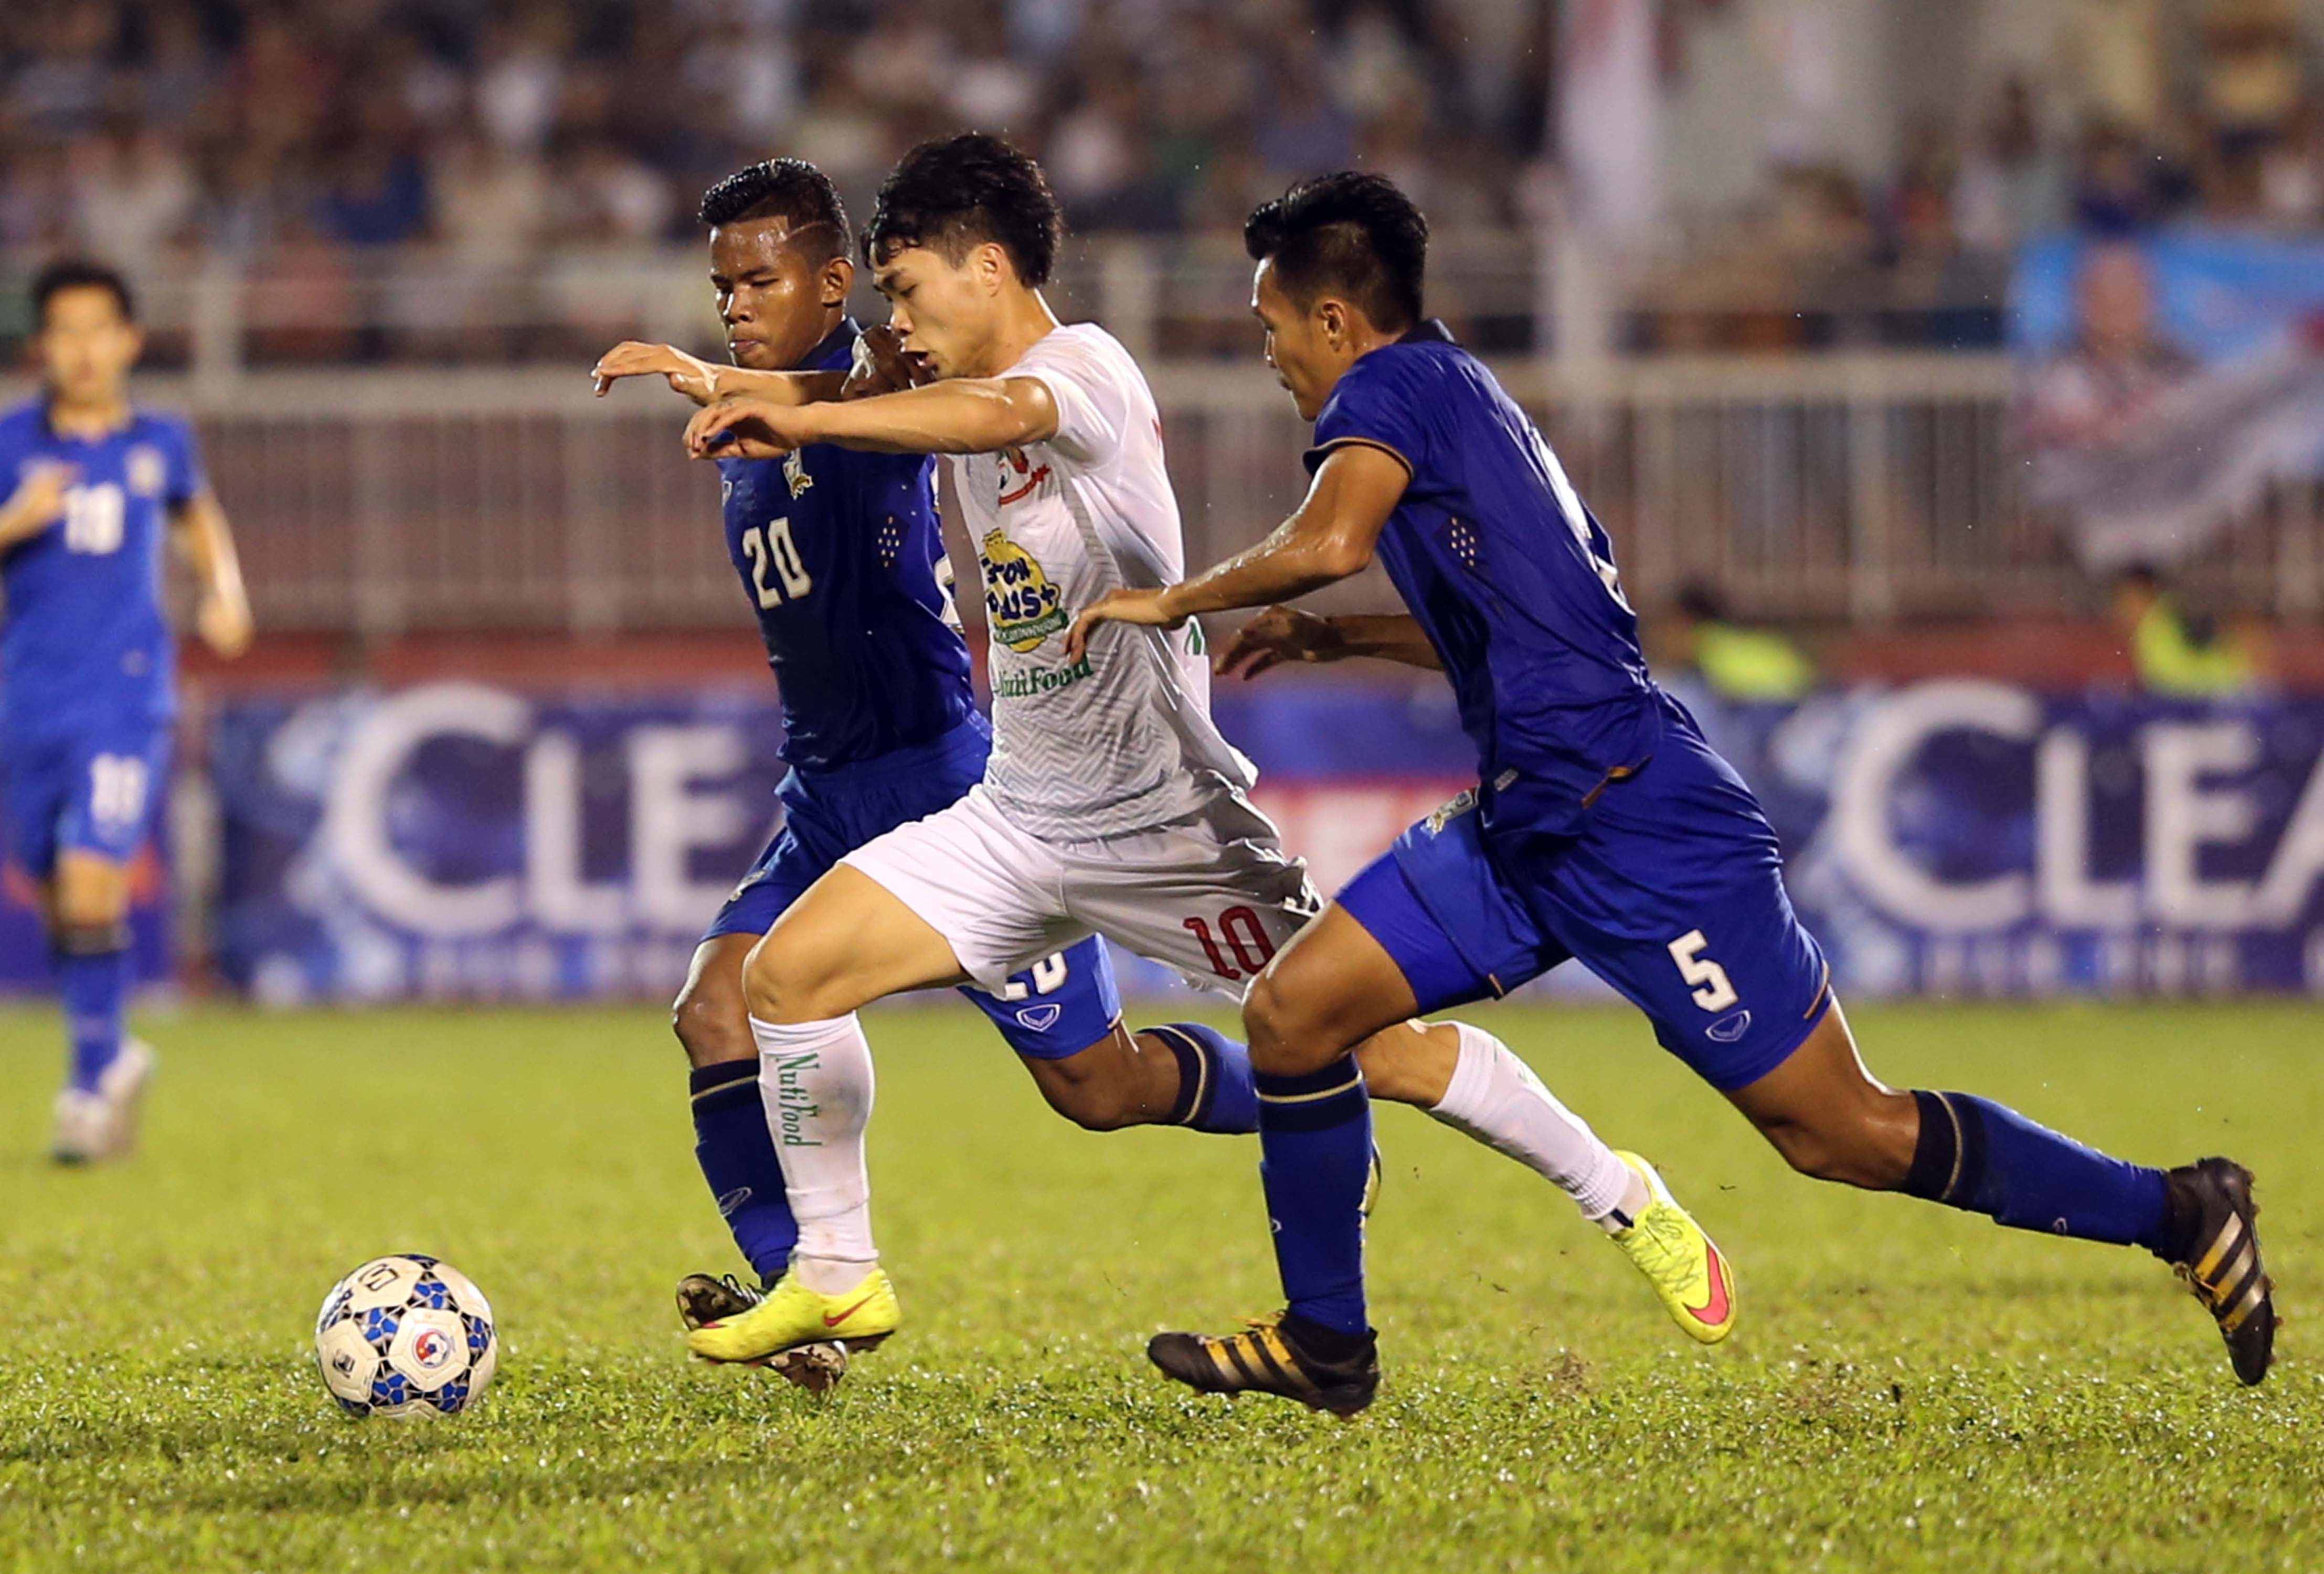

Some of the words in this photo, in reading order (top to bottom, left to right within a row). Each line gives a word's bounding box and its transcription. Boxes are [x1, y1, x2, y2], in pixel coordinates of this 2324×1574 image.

[741, 516, 812, 610] 20
[993, 652, 1094, 698] utiFood
[324, 681, 769, 935] CLE
[1183, 905, 1276, 980] 10
[1667, 929, 1739, 1014] 5
[776, 1052, 822, 1146] NutiFood
